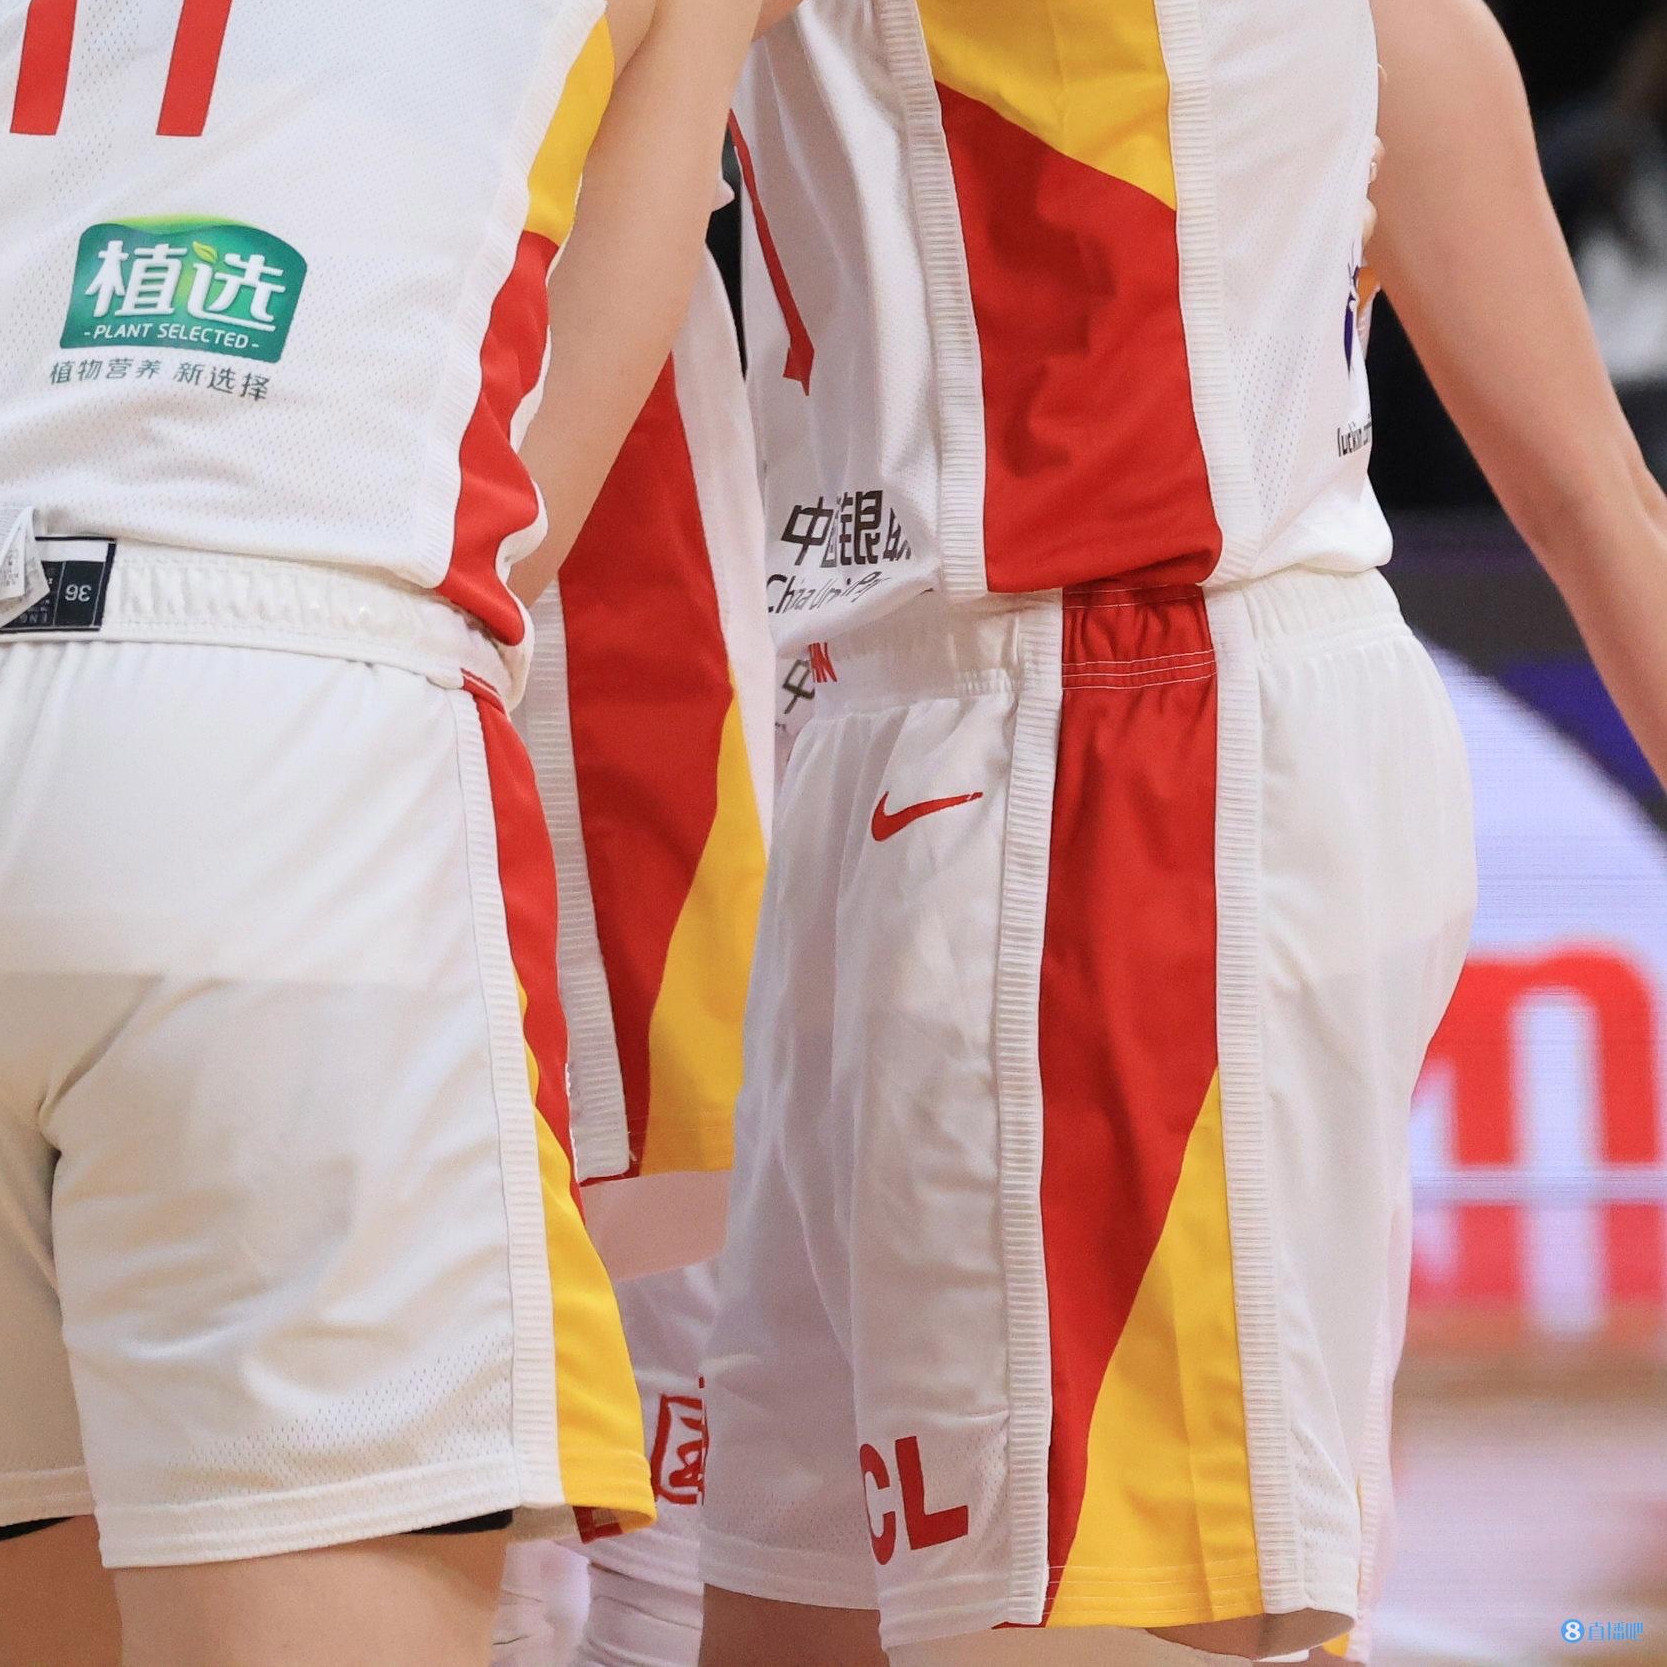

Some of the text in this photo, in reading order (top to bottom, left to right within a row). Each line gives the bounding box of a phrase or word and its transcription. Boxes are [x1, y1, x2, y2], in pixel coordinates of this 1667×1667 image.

[84, 240, 287, 332] 植选
[50, 358, 271, 402] 植物营养 新选择
[859, 1435, 969, 1566] CL
